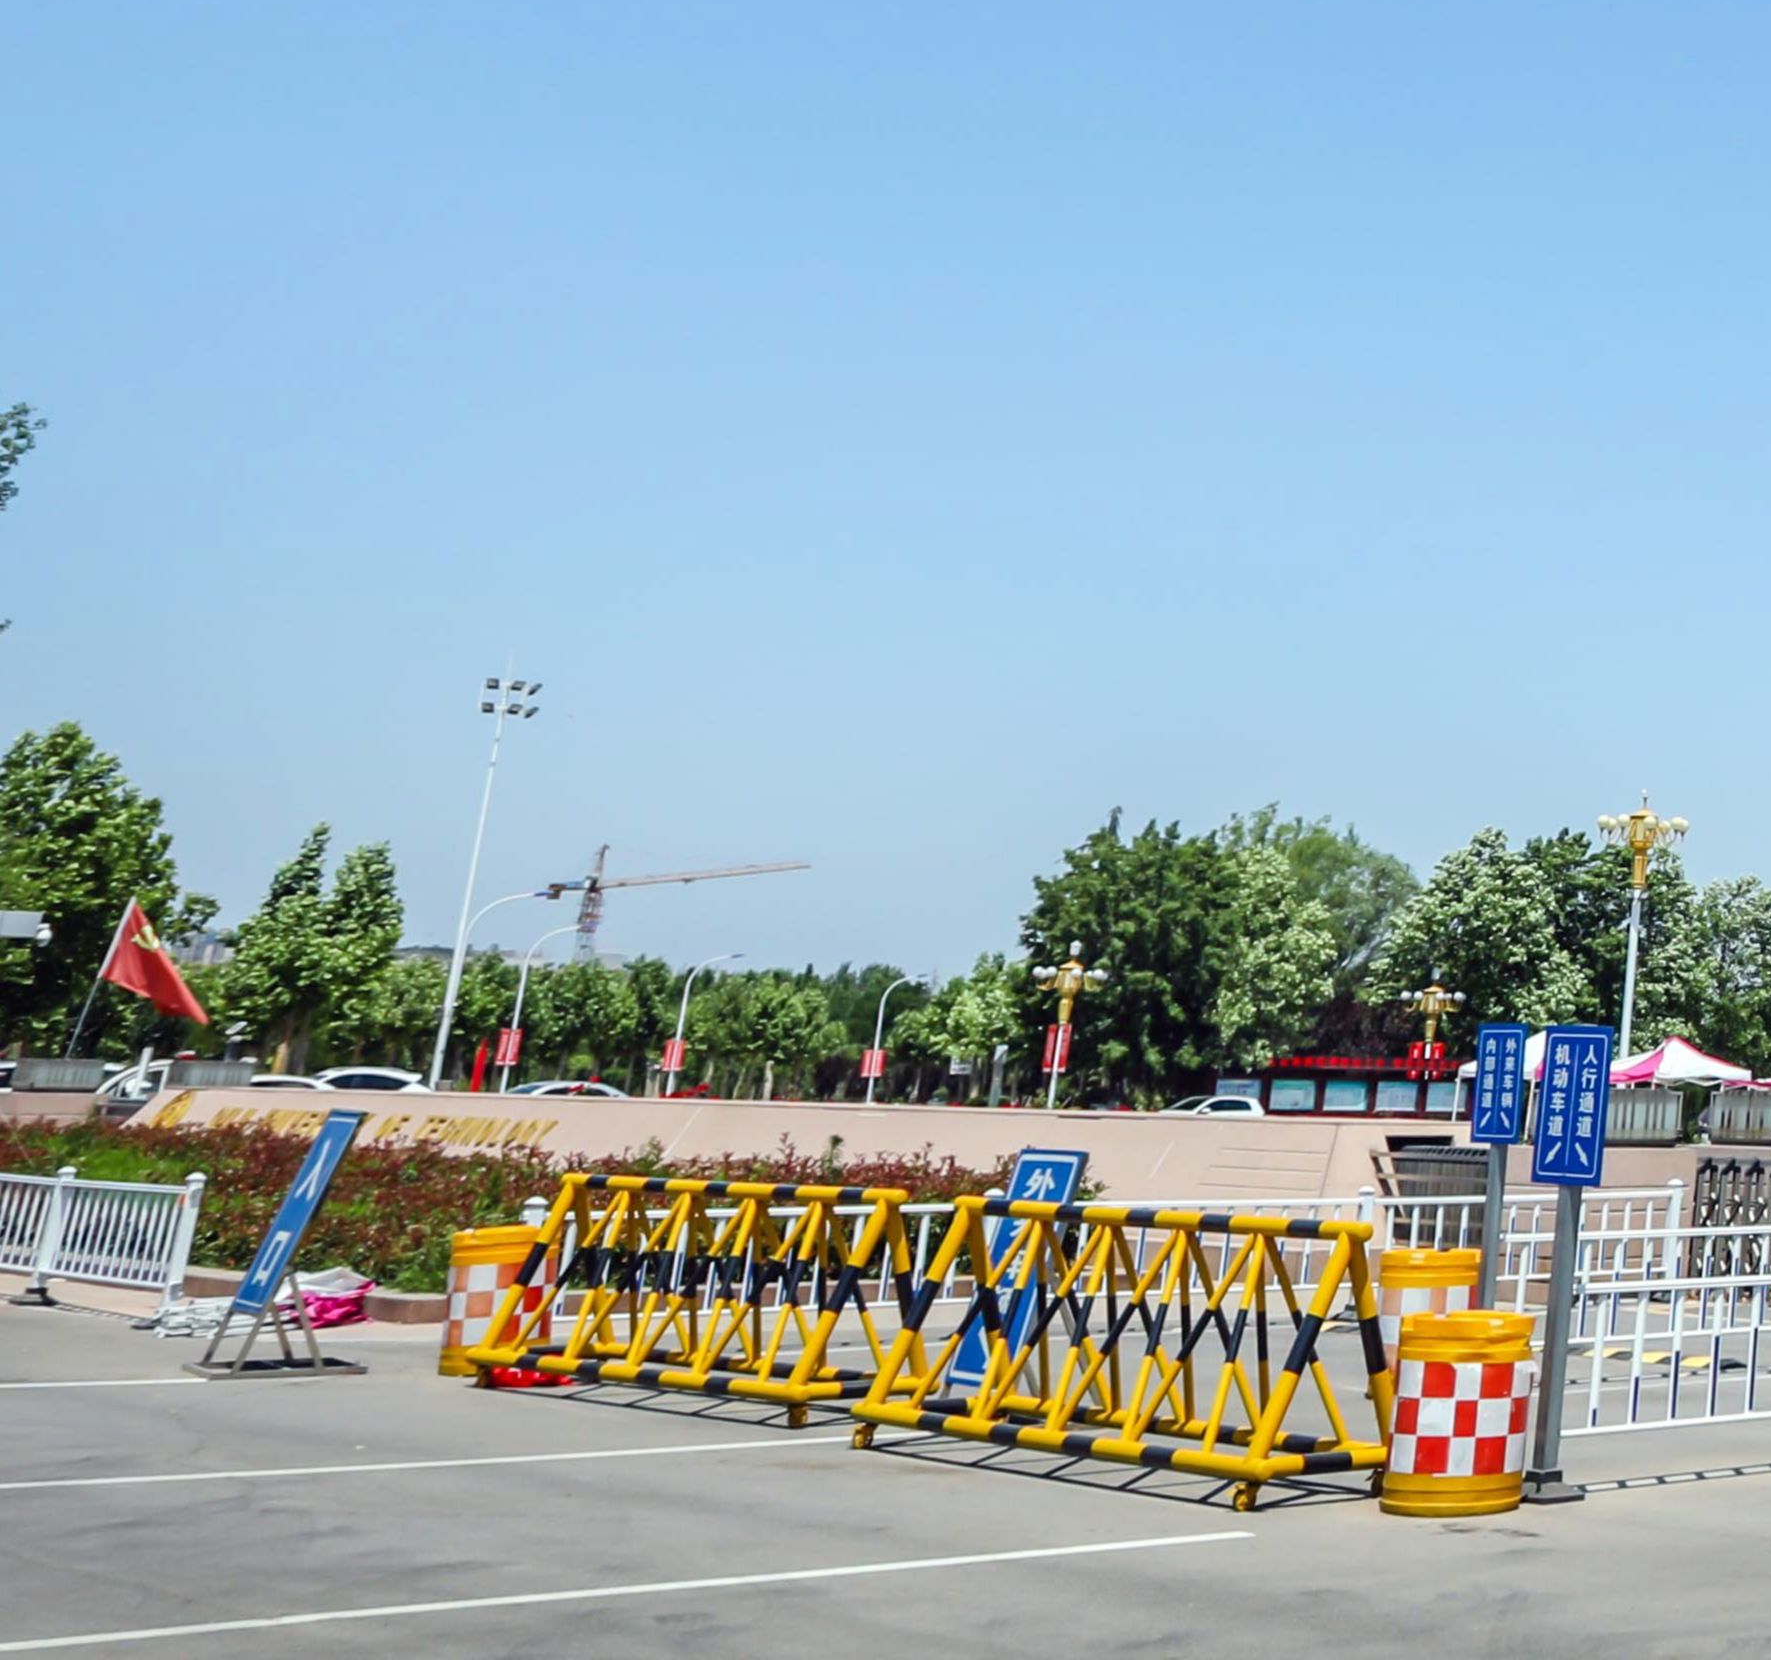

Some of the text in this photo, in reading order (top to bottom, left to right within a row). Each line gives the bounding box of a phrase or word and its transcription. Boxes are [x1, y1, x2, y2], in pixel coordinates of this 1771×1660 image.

[1481, 1037, 1497, 1109] 内部通道
[1500, 1037, 1517, 1109] 外来车辆
[1547, 1043, 1571, 1137] 机动车道
[1575, 1044, 1599, 1138] 人行通道
[251, 1138, 333, 1287] 入口
